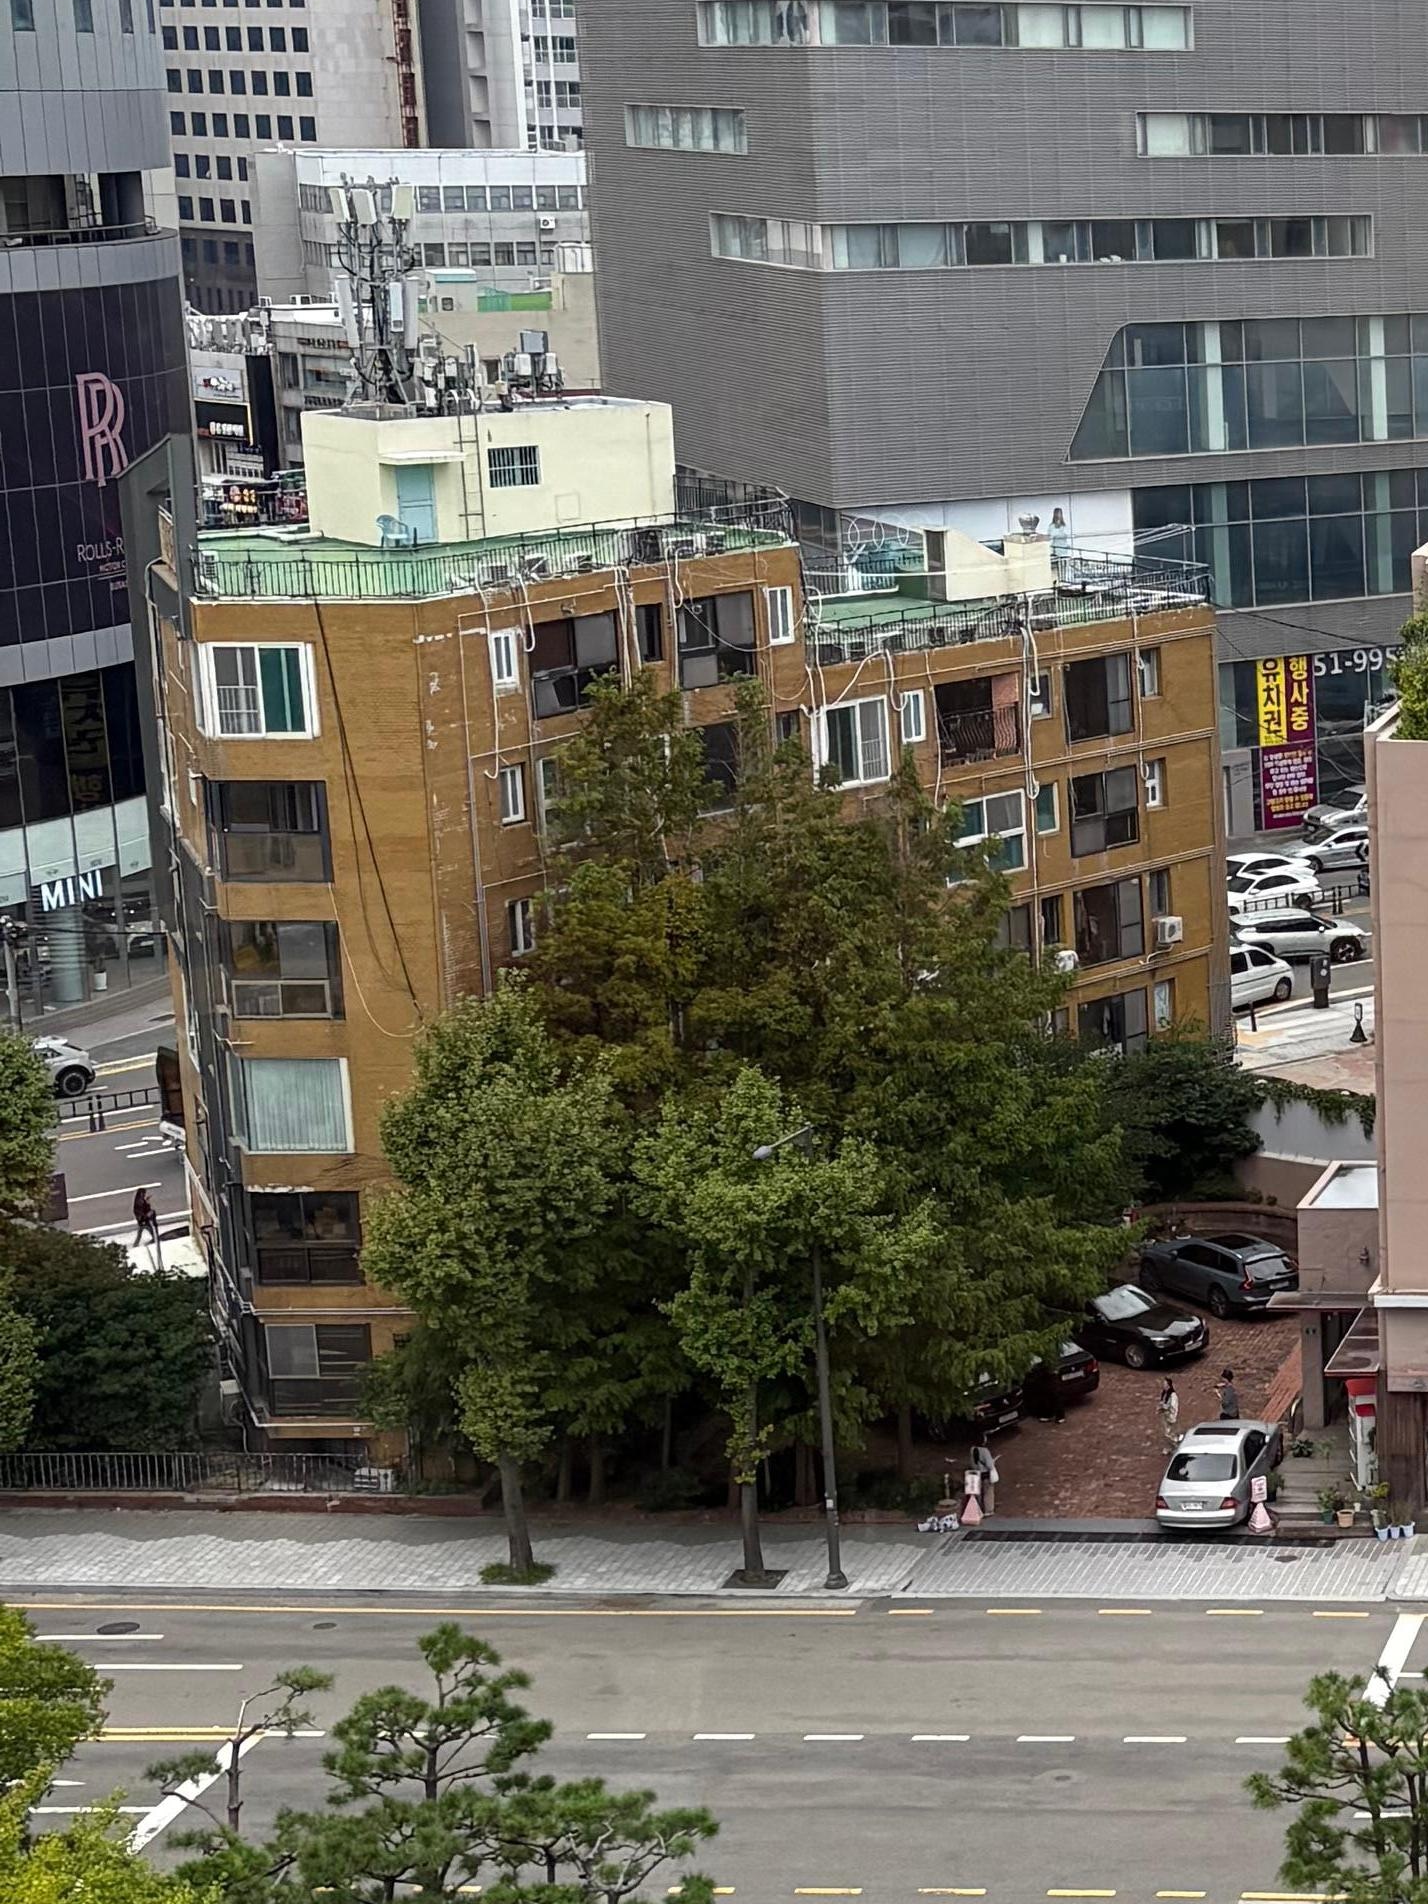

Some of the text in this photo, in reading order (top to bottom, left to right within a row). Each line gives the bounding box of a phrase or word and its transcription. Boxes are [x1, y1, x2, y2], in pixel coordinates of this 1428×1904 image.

[77, 536, 125, 562] ROLLS-R
[1262, 657, 1283, 737] 유치권
[1288, 656, 1310, 731] 행사중
[41, 869, 103, 912] MINI
